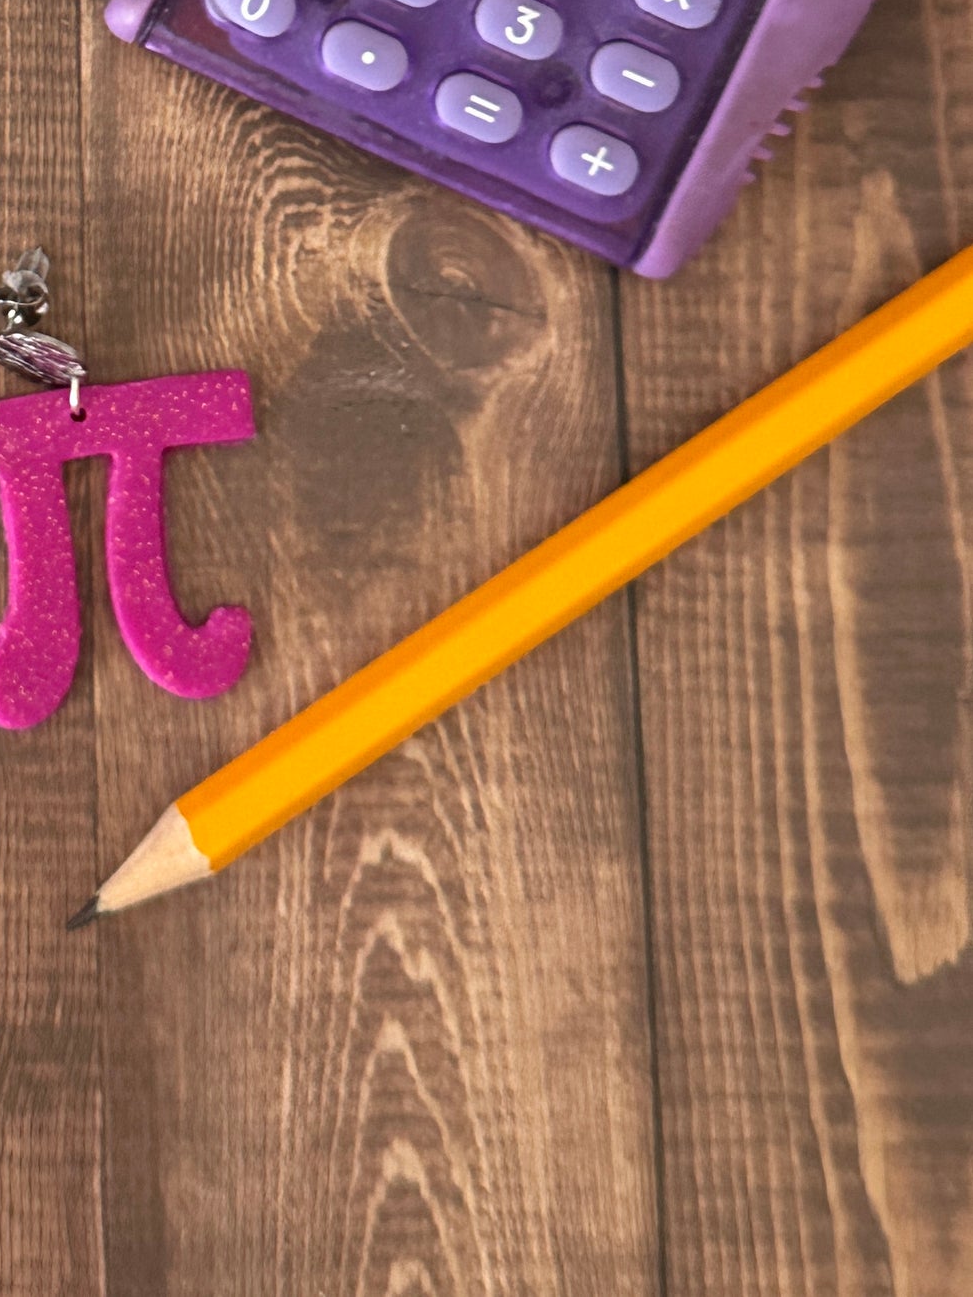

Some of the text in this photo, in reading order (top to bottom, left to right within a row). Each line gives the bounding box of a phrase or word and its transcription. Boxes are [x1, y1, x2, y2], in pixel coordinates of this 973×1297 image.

[504, 5, 540, 44] 3
[464, 94, 500, 123] =
[580, 146, 613, 175] +
